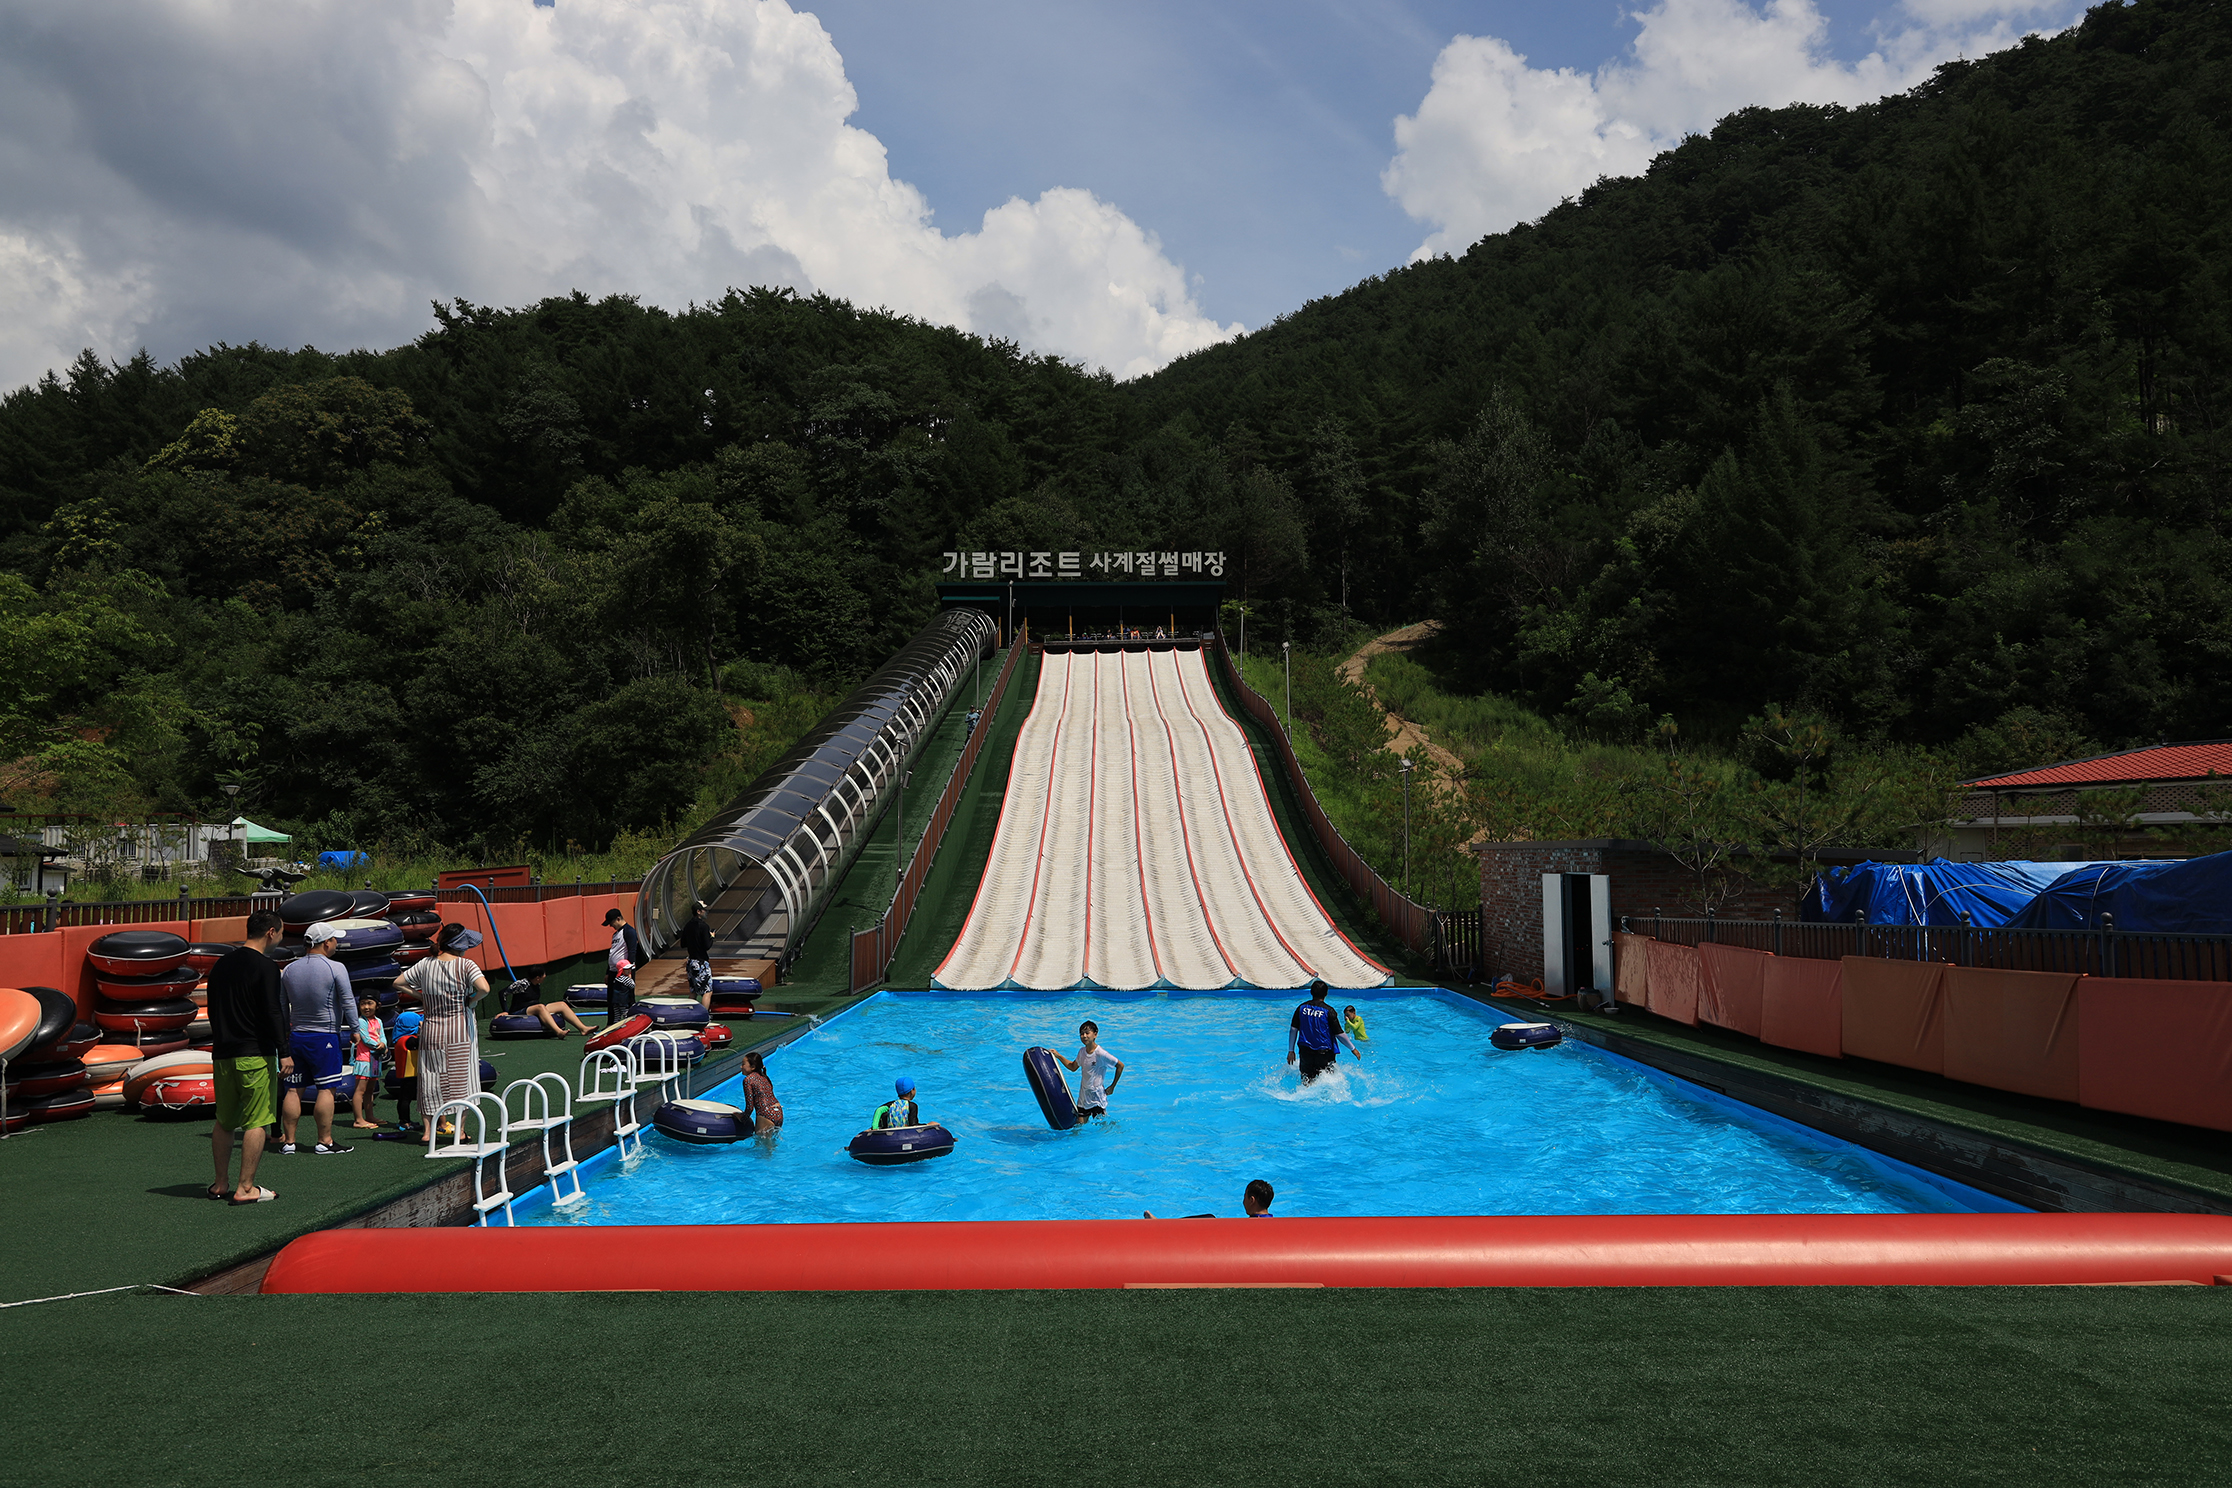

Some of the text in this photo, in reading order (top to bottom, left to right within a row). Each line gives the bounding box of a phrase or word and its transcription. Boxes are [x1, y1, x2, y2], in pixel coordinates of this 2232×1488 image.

[943, 551, 1227, 579] 가람리조트 사계절썰매장
[1302, 1007, 1325, 1018] STAFF
